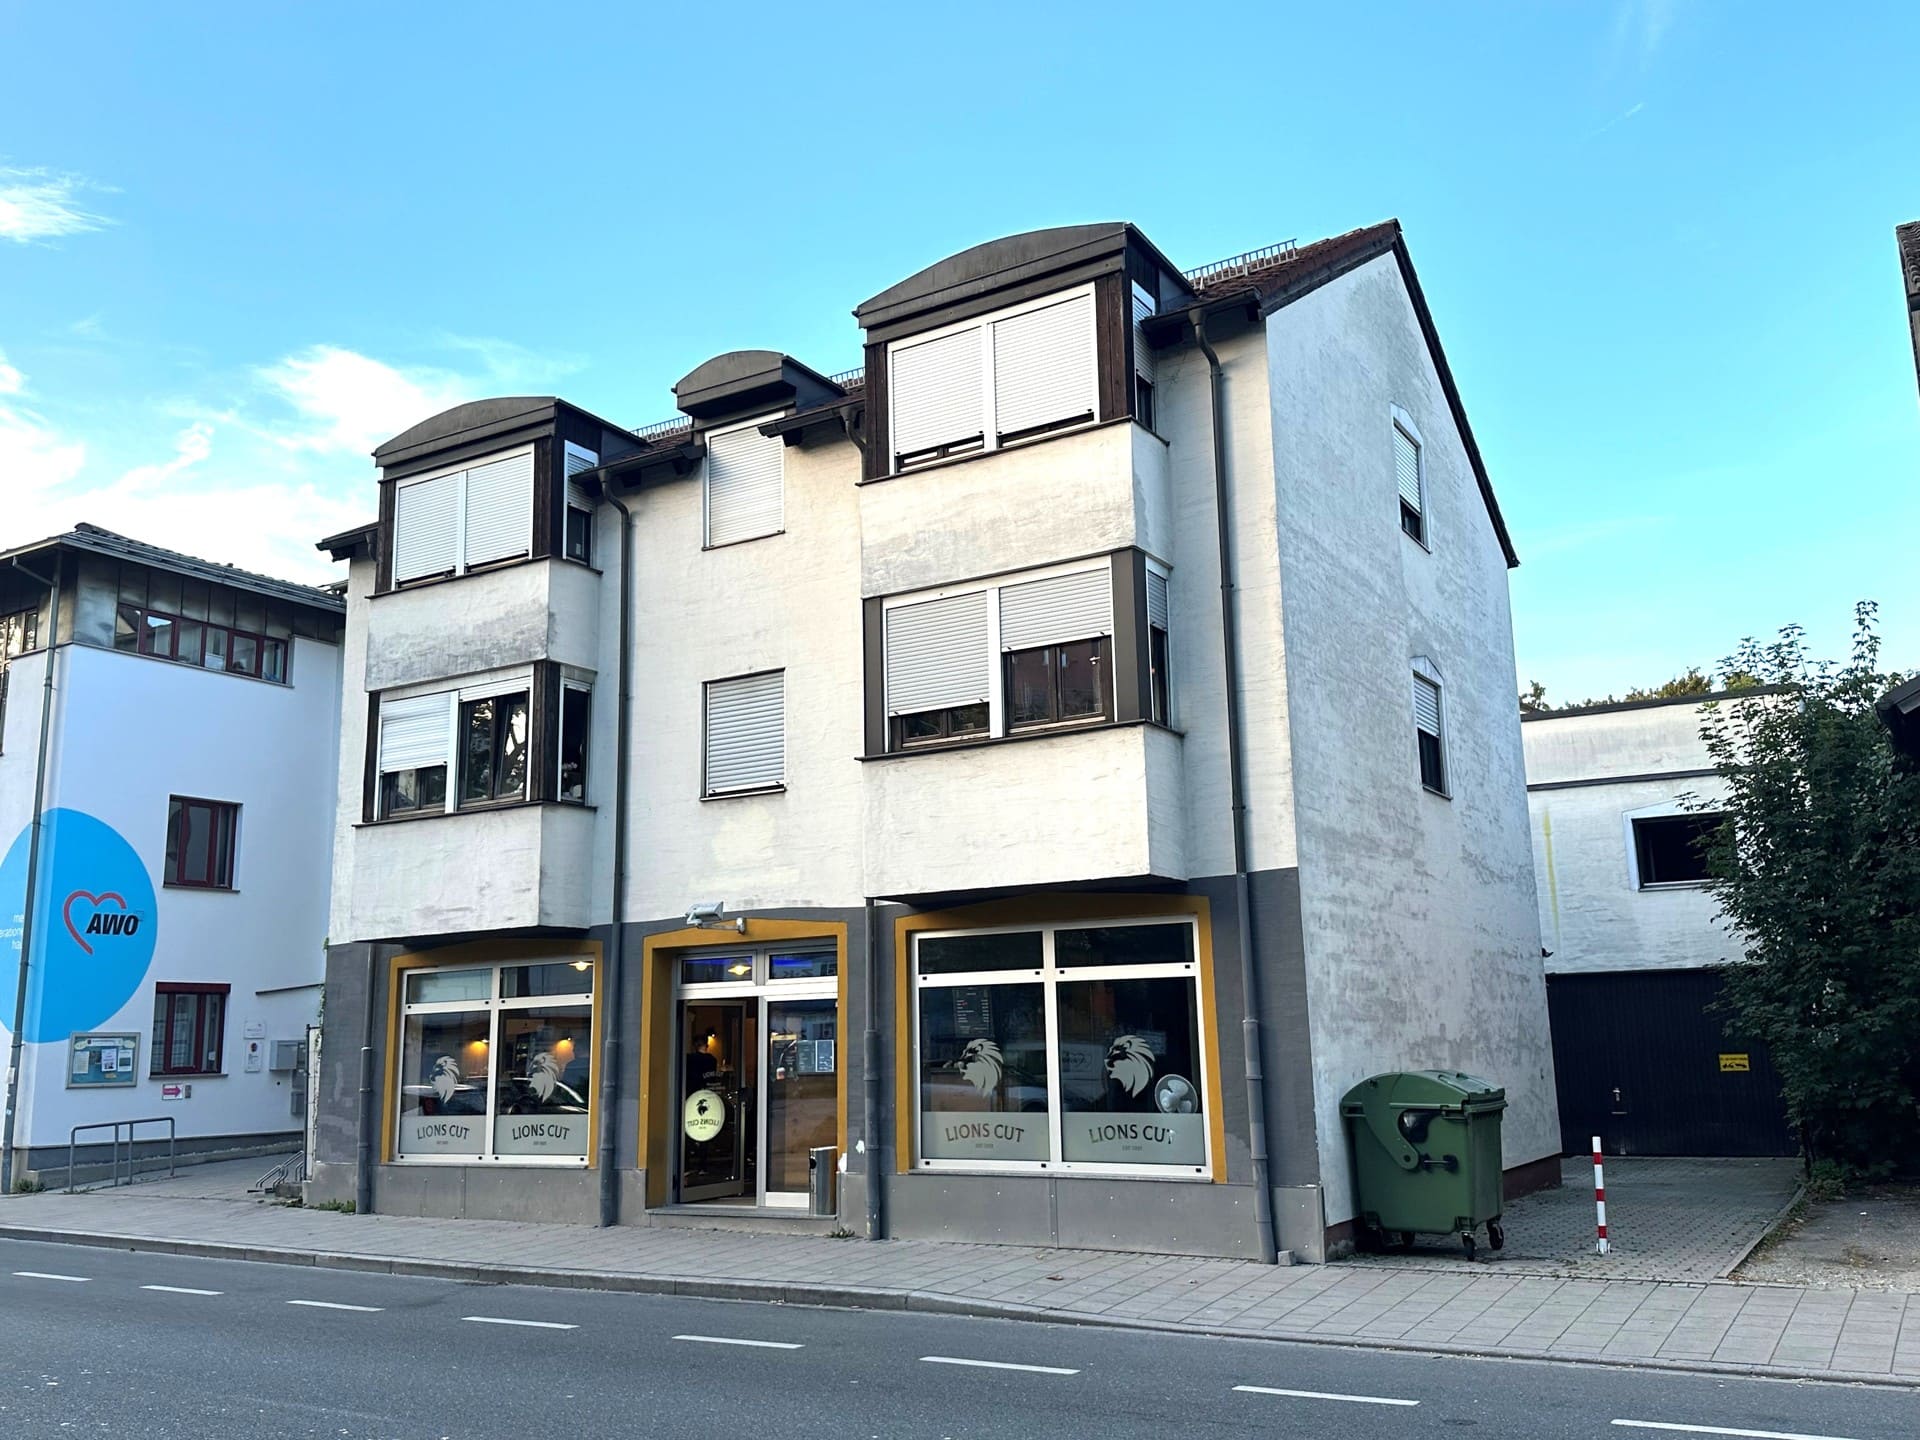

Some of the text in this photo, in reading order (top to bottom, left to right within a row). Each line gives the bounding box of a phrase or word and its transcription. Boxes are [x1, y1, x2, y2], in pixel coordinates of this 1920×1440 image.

[86, 912, 139, 936] AWO
[417, 1124, 470, 1140] LIONS CUT
[512, 1124, 570, 1140] LIONS CUT
[945, 1123, 1024, 1142] LIONS CUT
[1088, 1124, 1138, 1144] LIONS
